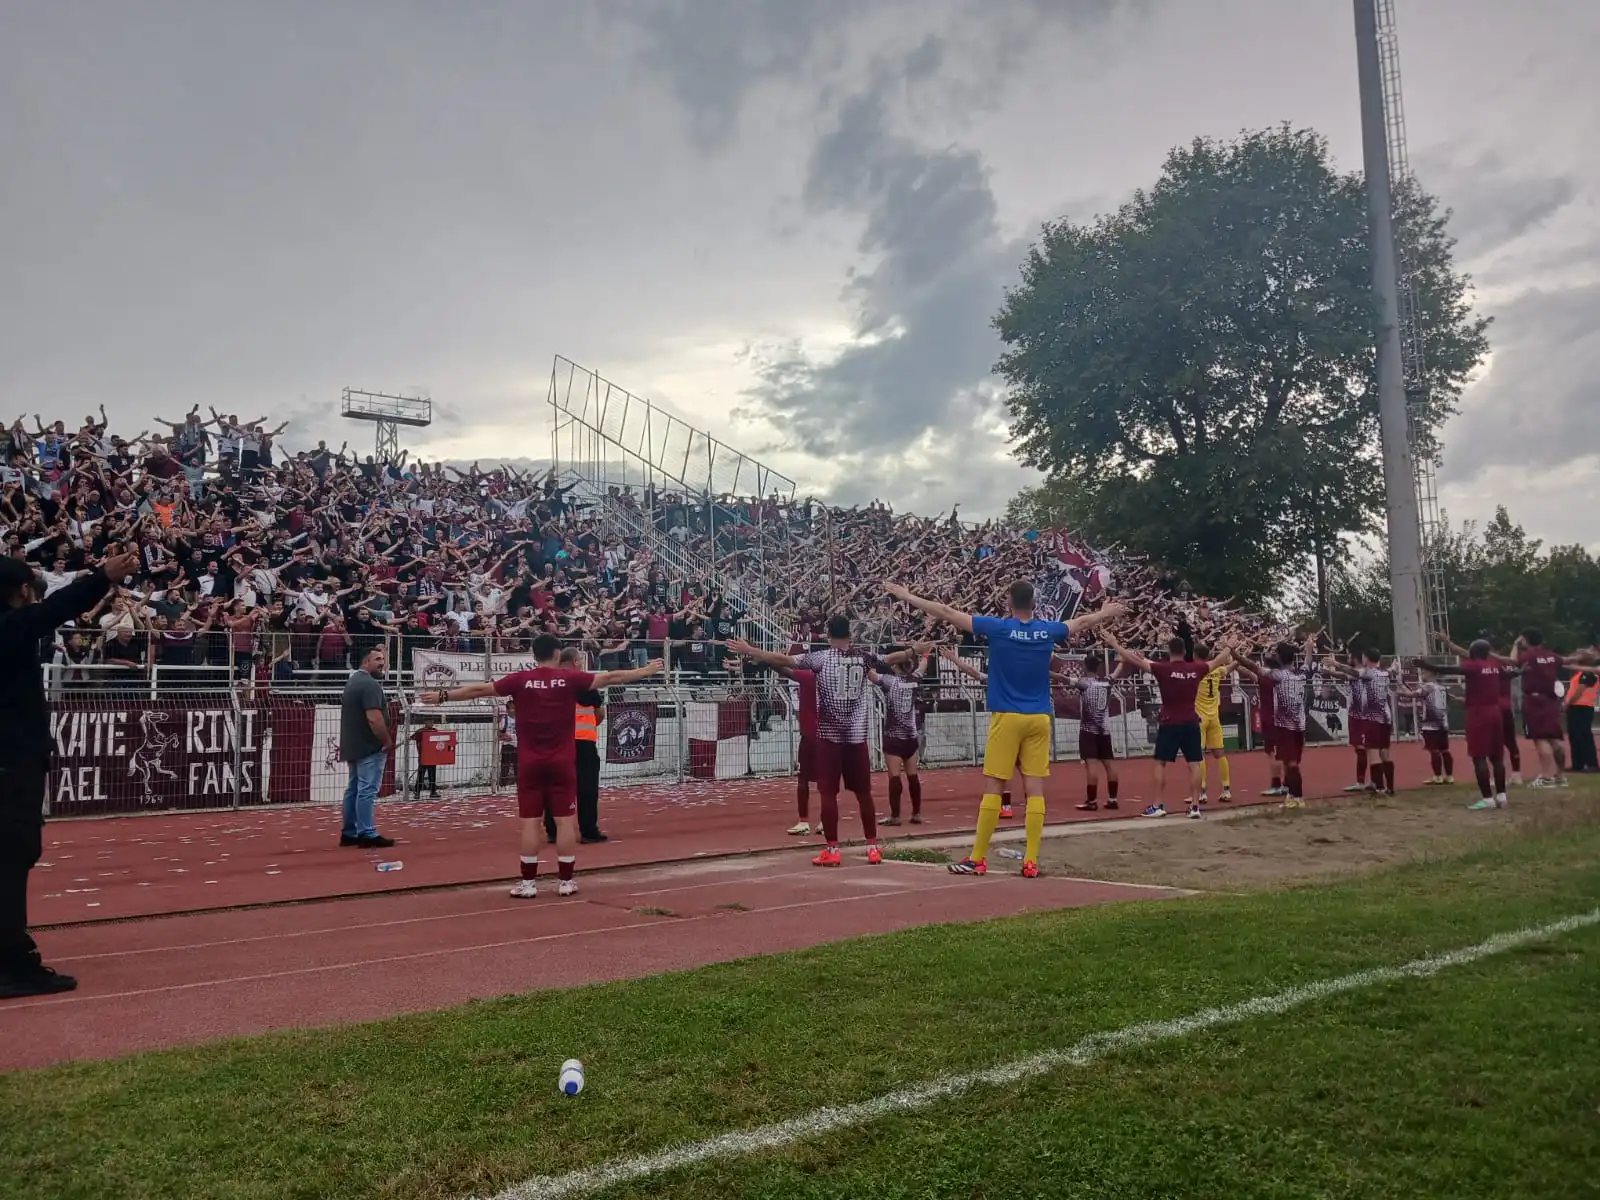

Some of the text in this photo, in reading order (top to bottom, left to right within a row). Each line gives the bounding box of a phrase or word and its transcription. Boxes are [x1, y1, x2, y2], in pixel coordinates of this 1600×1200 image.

[1010, 630, 1048, 640] AEL FC
[525, 679, 566, 689] AEL FC
[835, 665, 864, 700] 19
[1170, 671, 1186, 679] AEL
[1205, 679, 1214, 698] 1
[186, 709, 258, 753] RINI
[57, 761, 254, 802] AEL FANS
